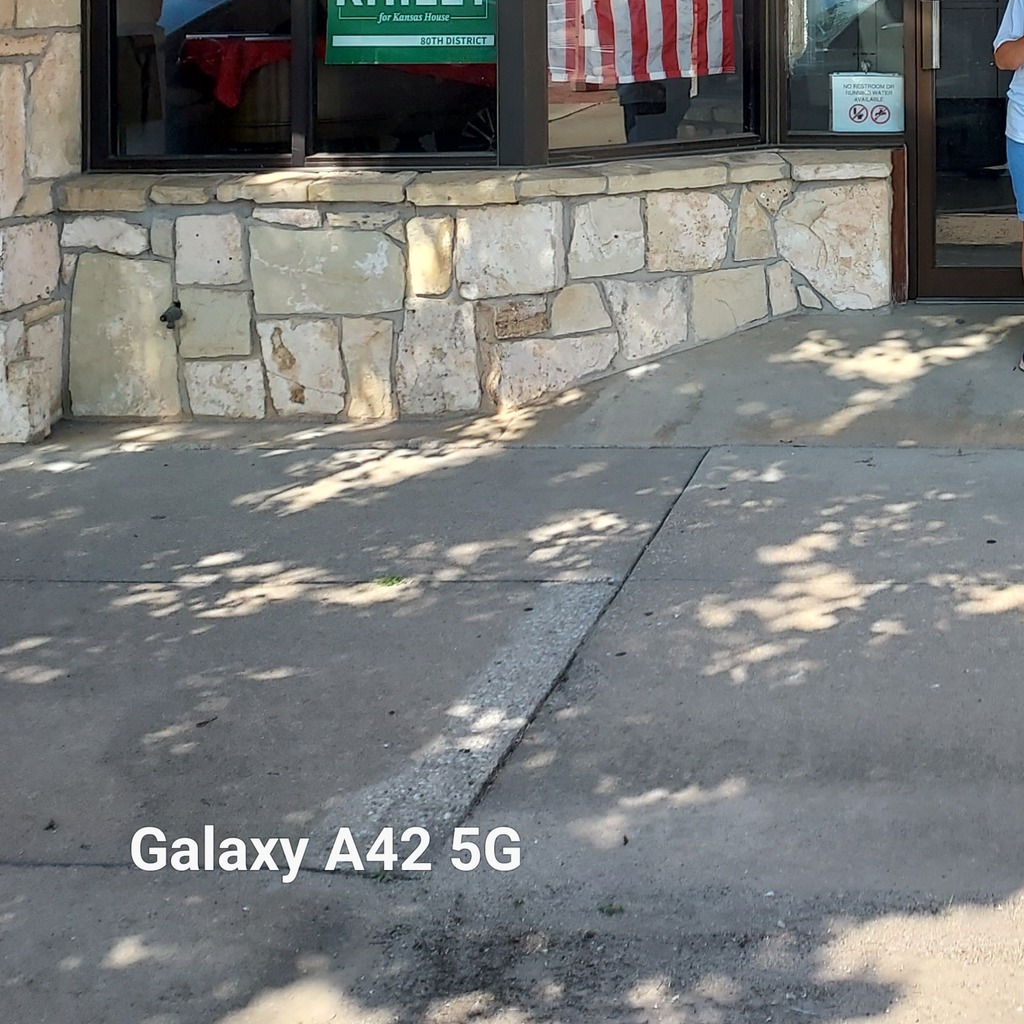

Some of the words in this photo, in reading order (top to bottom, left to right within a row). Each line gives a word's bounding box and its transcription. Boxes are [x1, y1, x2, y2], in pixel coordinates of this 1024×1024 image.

[377, 12, 392, 24] for
[392, 13, 423, 22] Kansas
[424, 12, 450, 22] House
[420, 36, 443, 45] 80TH
[445, 36, 488, 45] DISTRICT
